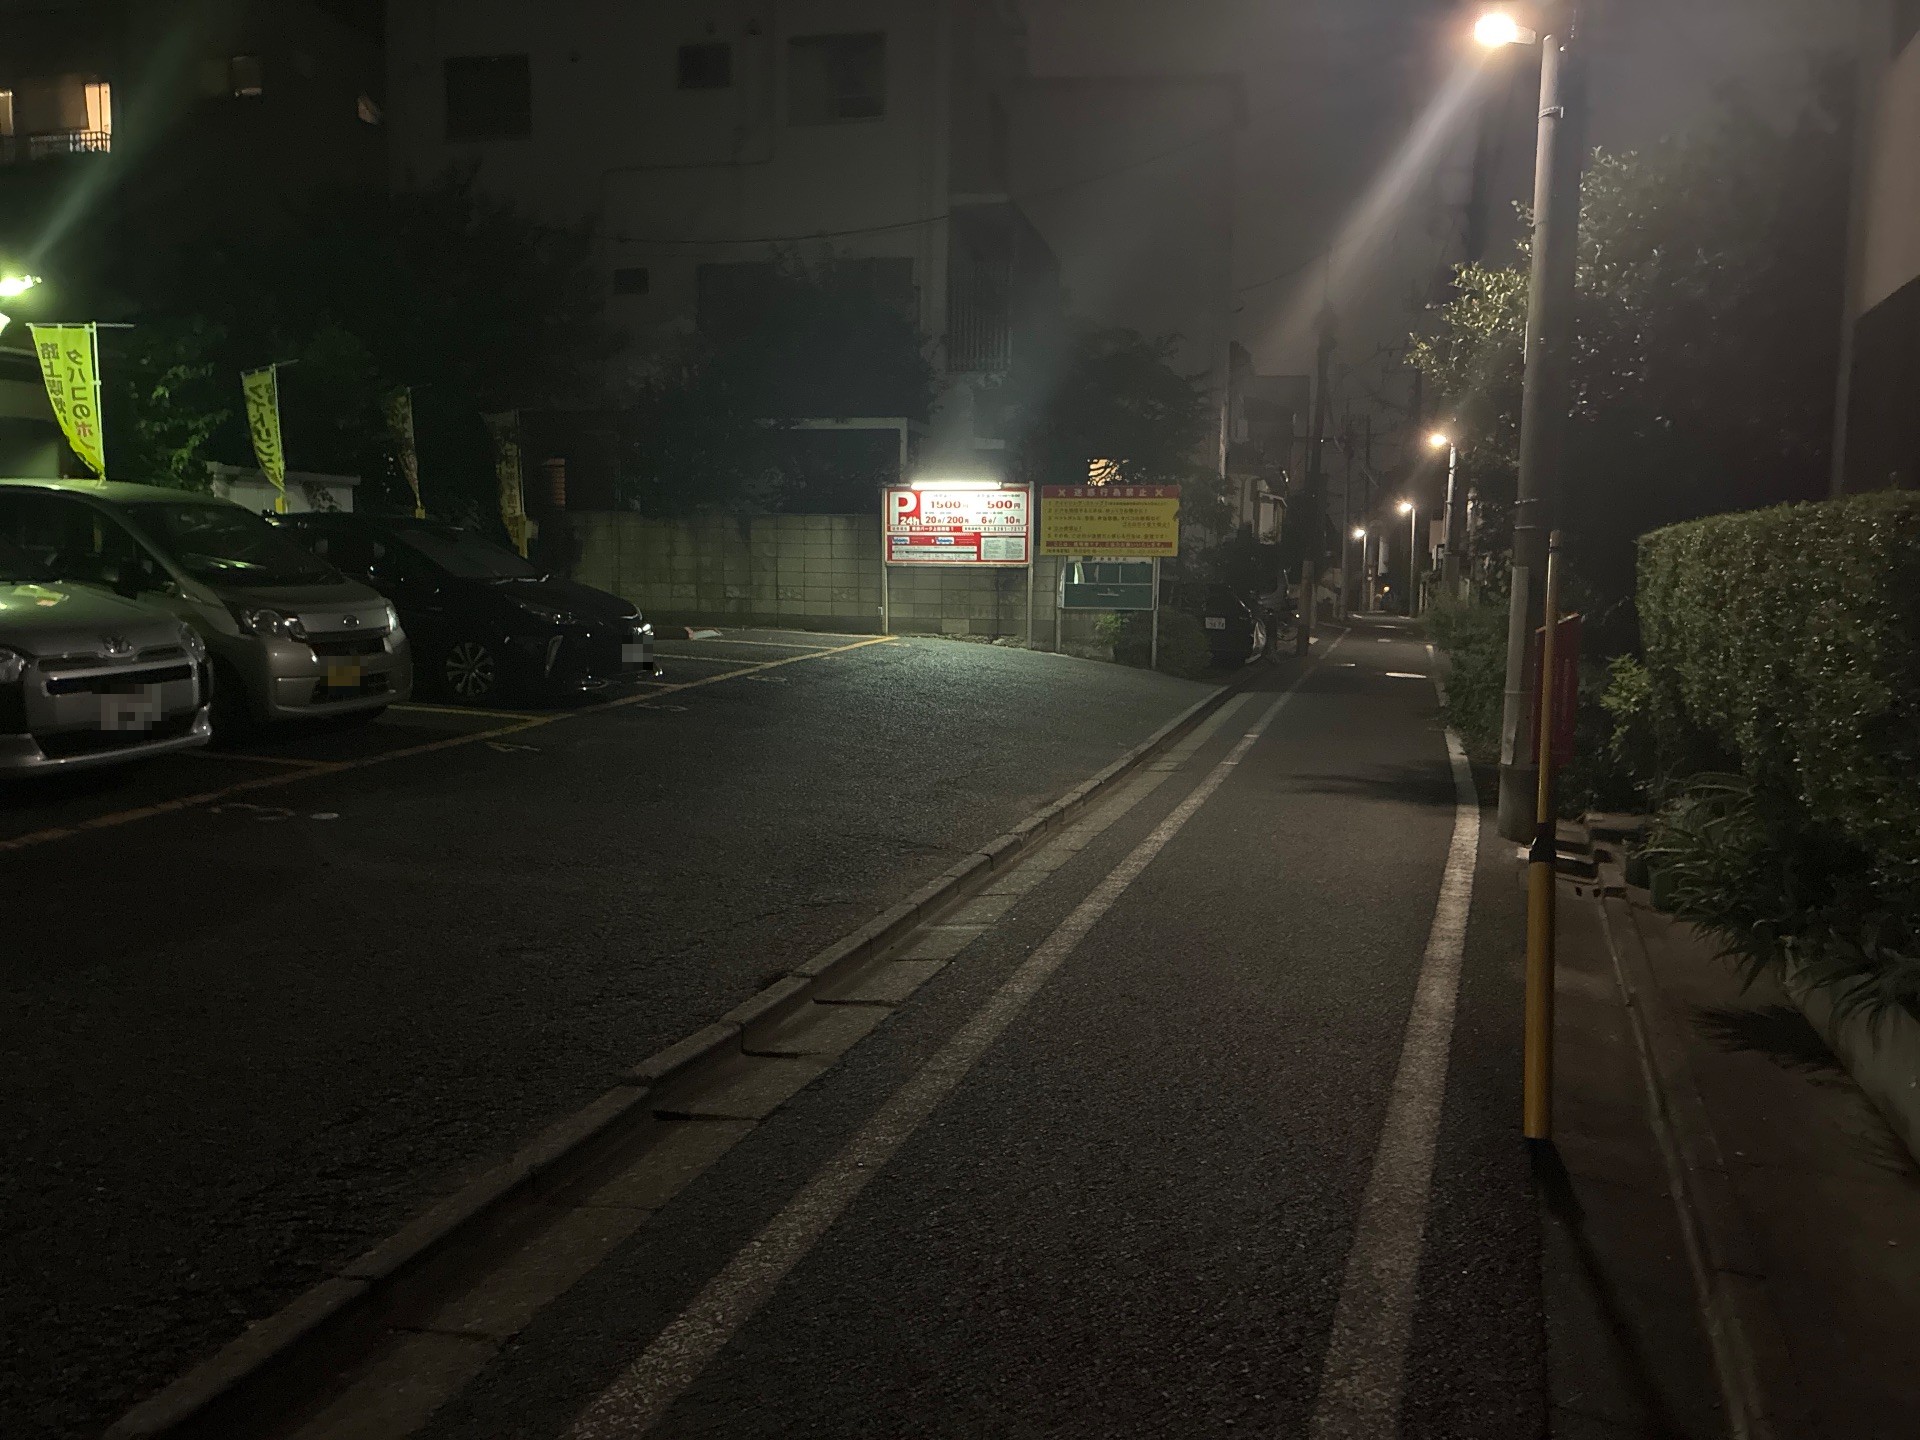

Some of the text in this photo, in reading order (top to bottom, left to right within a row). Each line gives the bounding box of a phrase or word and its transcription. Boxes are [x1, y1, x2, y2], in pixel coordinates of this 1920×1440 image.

[1073, 488, 1147, 498] 迷惑行為禁止
[890, 492, 917, 526] P
[899, 516, 920, 526] 24h
